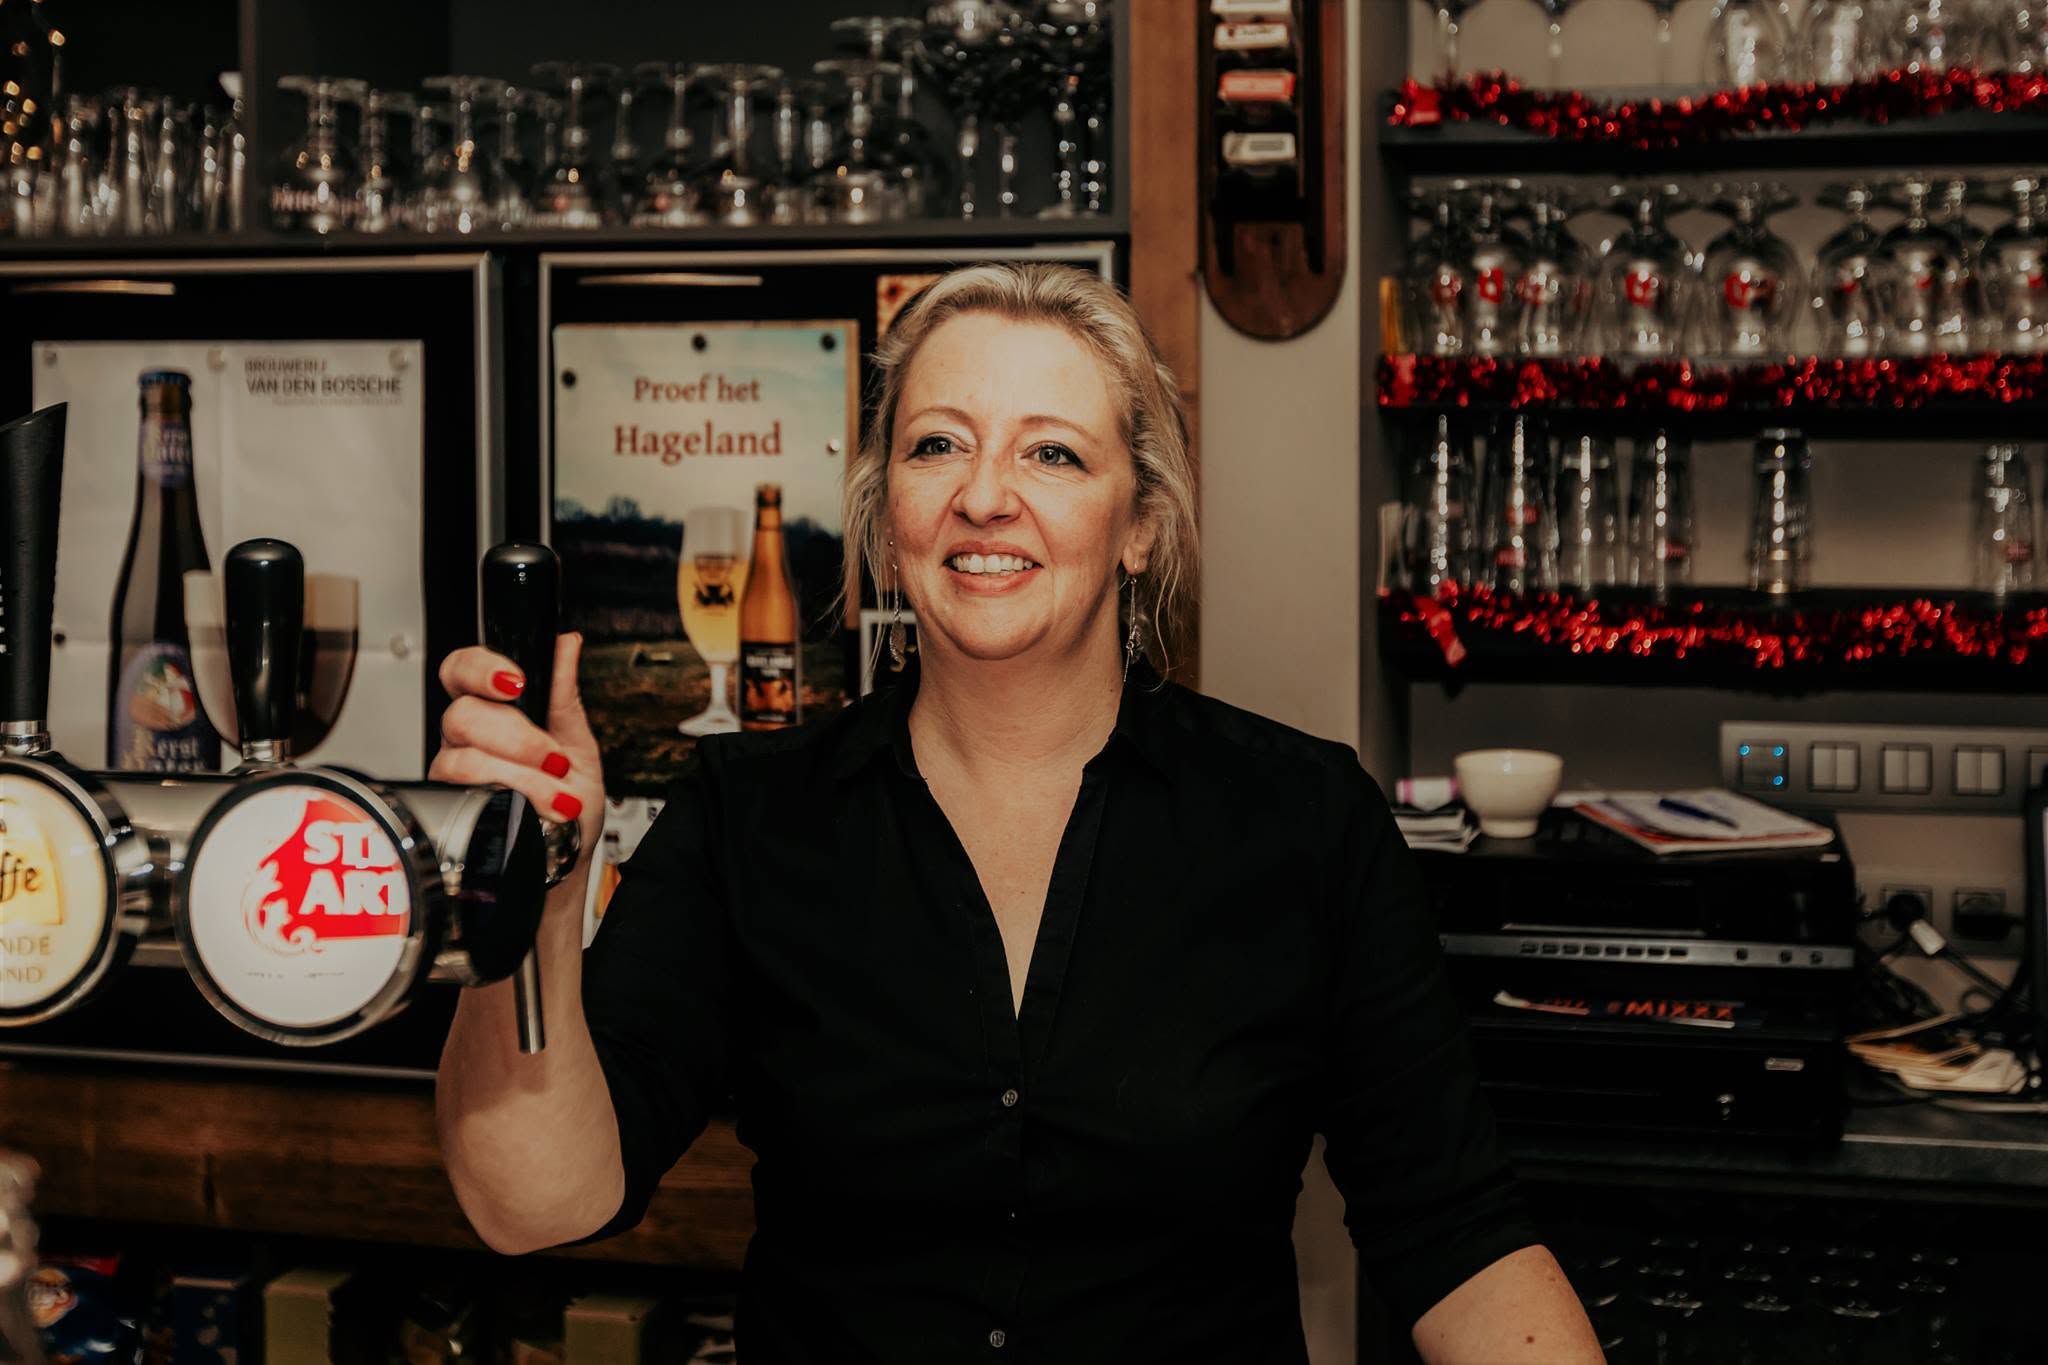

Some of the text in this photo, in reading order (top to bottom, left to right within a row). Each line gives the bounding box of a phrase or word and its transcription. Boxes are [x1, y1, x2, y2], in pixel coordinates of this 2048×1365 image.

[246, 375, 402, 394] VAN DEN BOSSCHE
[634, 373, 760, 401] Proef het
[613, 420, 782, 467] Hageland
